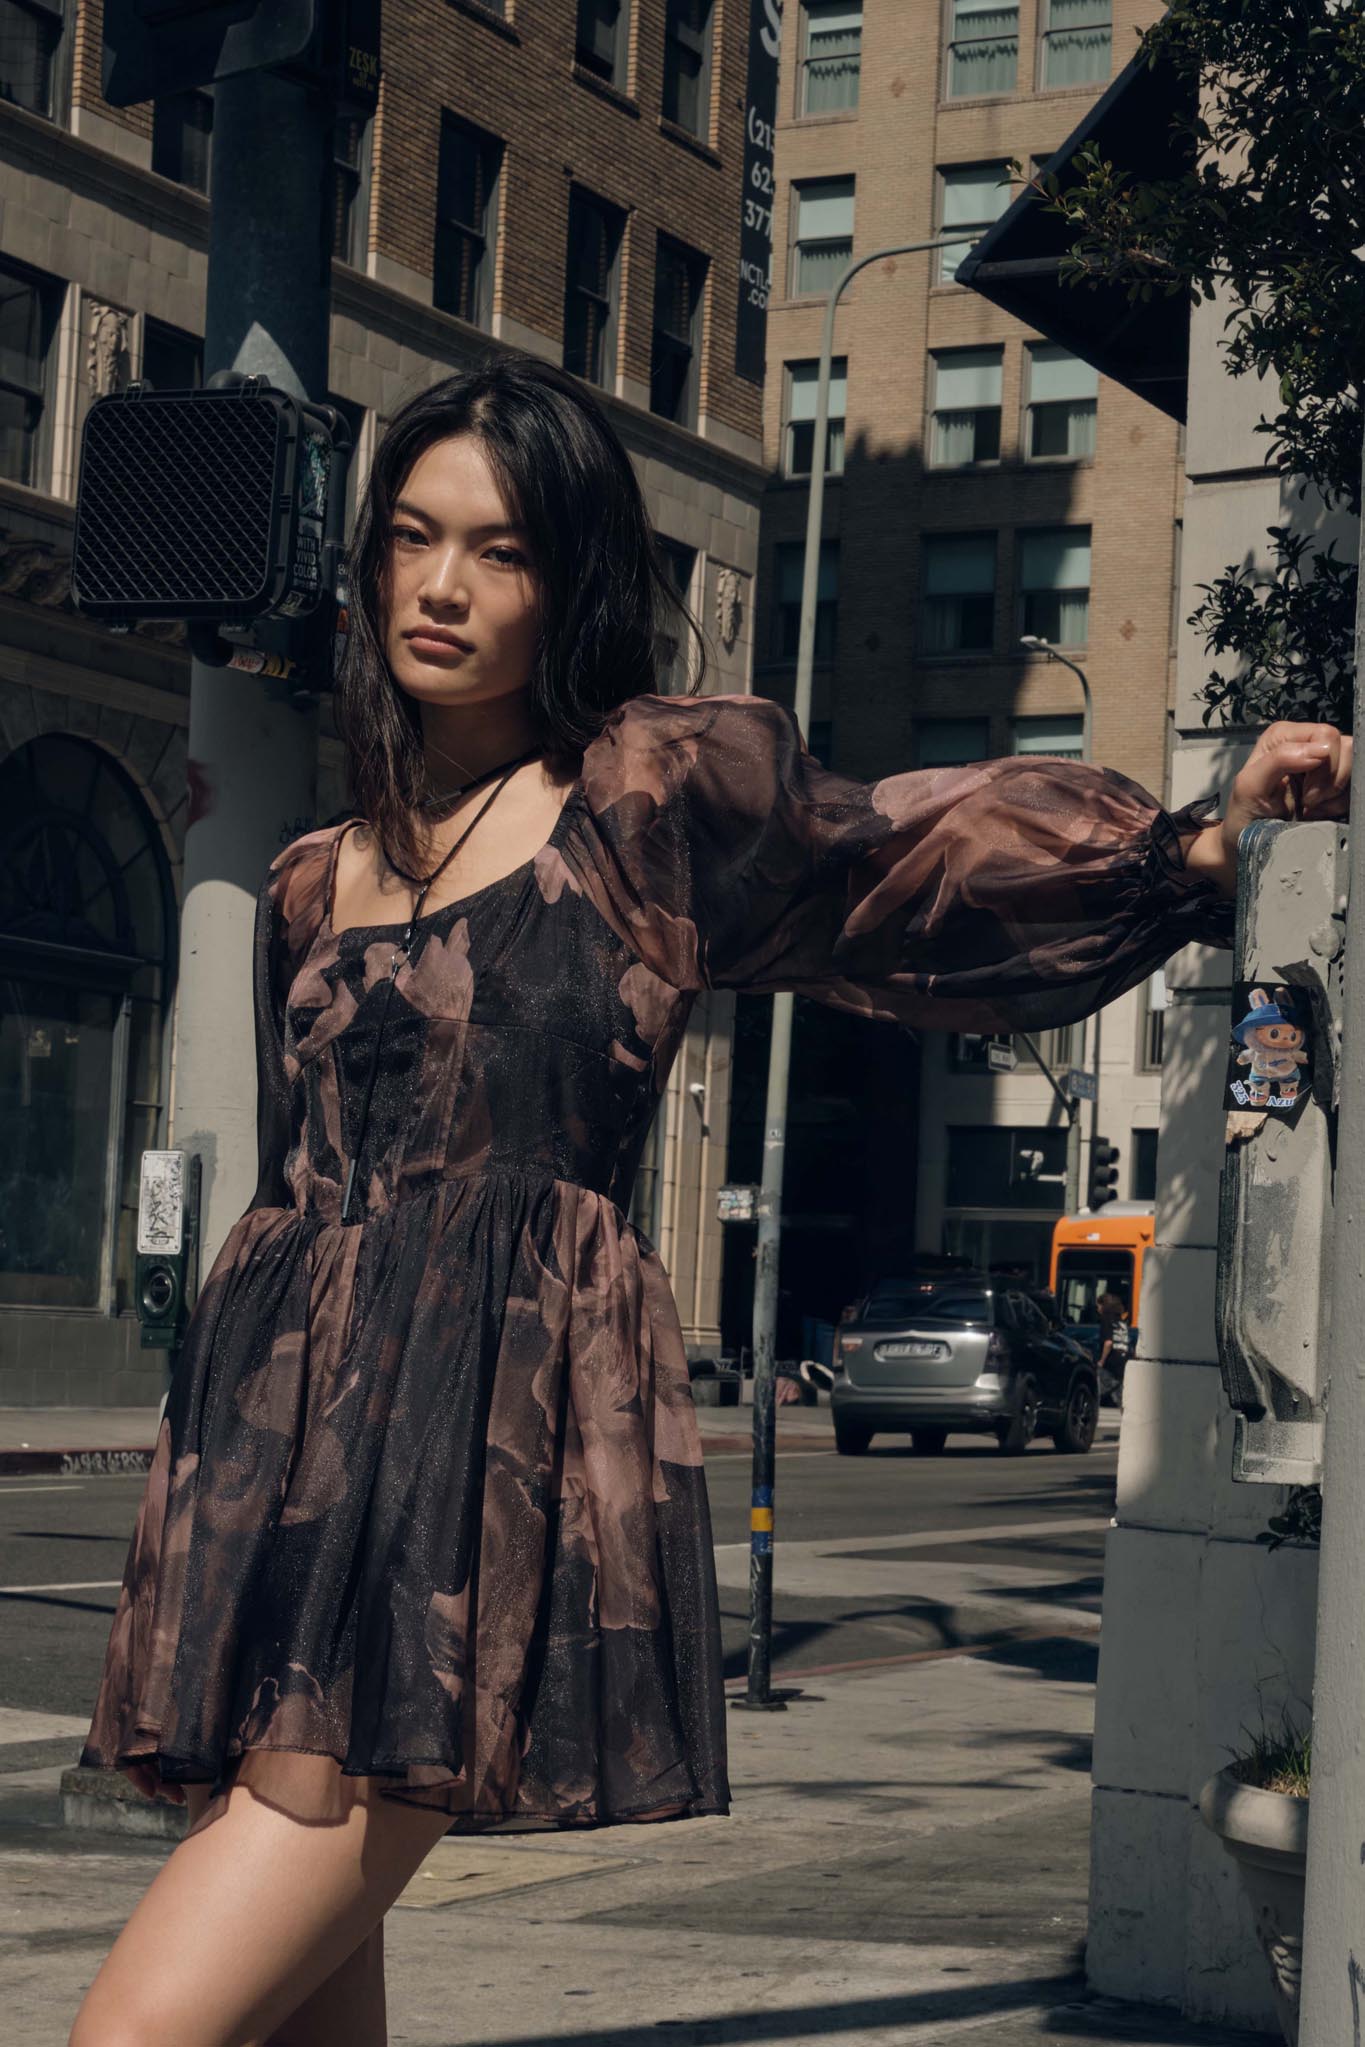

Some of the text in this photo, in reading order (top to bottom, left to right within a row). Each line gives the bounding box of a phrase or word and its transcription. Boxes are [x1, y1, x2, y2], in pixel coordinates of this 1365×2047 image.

[748, 106, 775, 151] (21
[751, 161, 774, 195] 62
[297, 536, 316, 552] WITH
[296, 549, 317, 566] VIVID
[293, 563, 318, 581] COLOR
